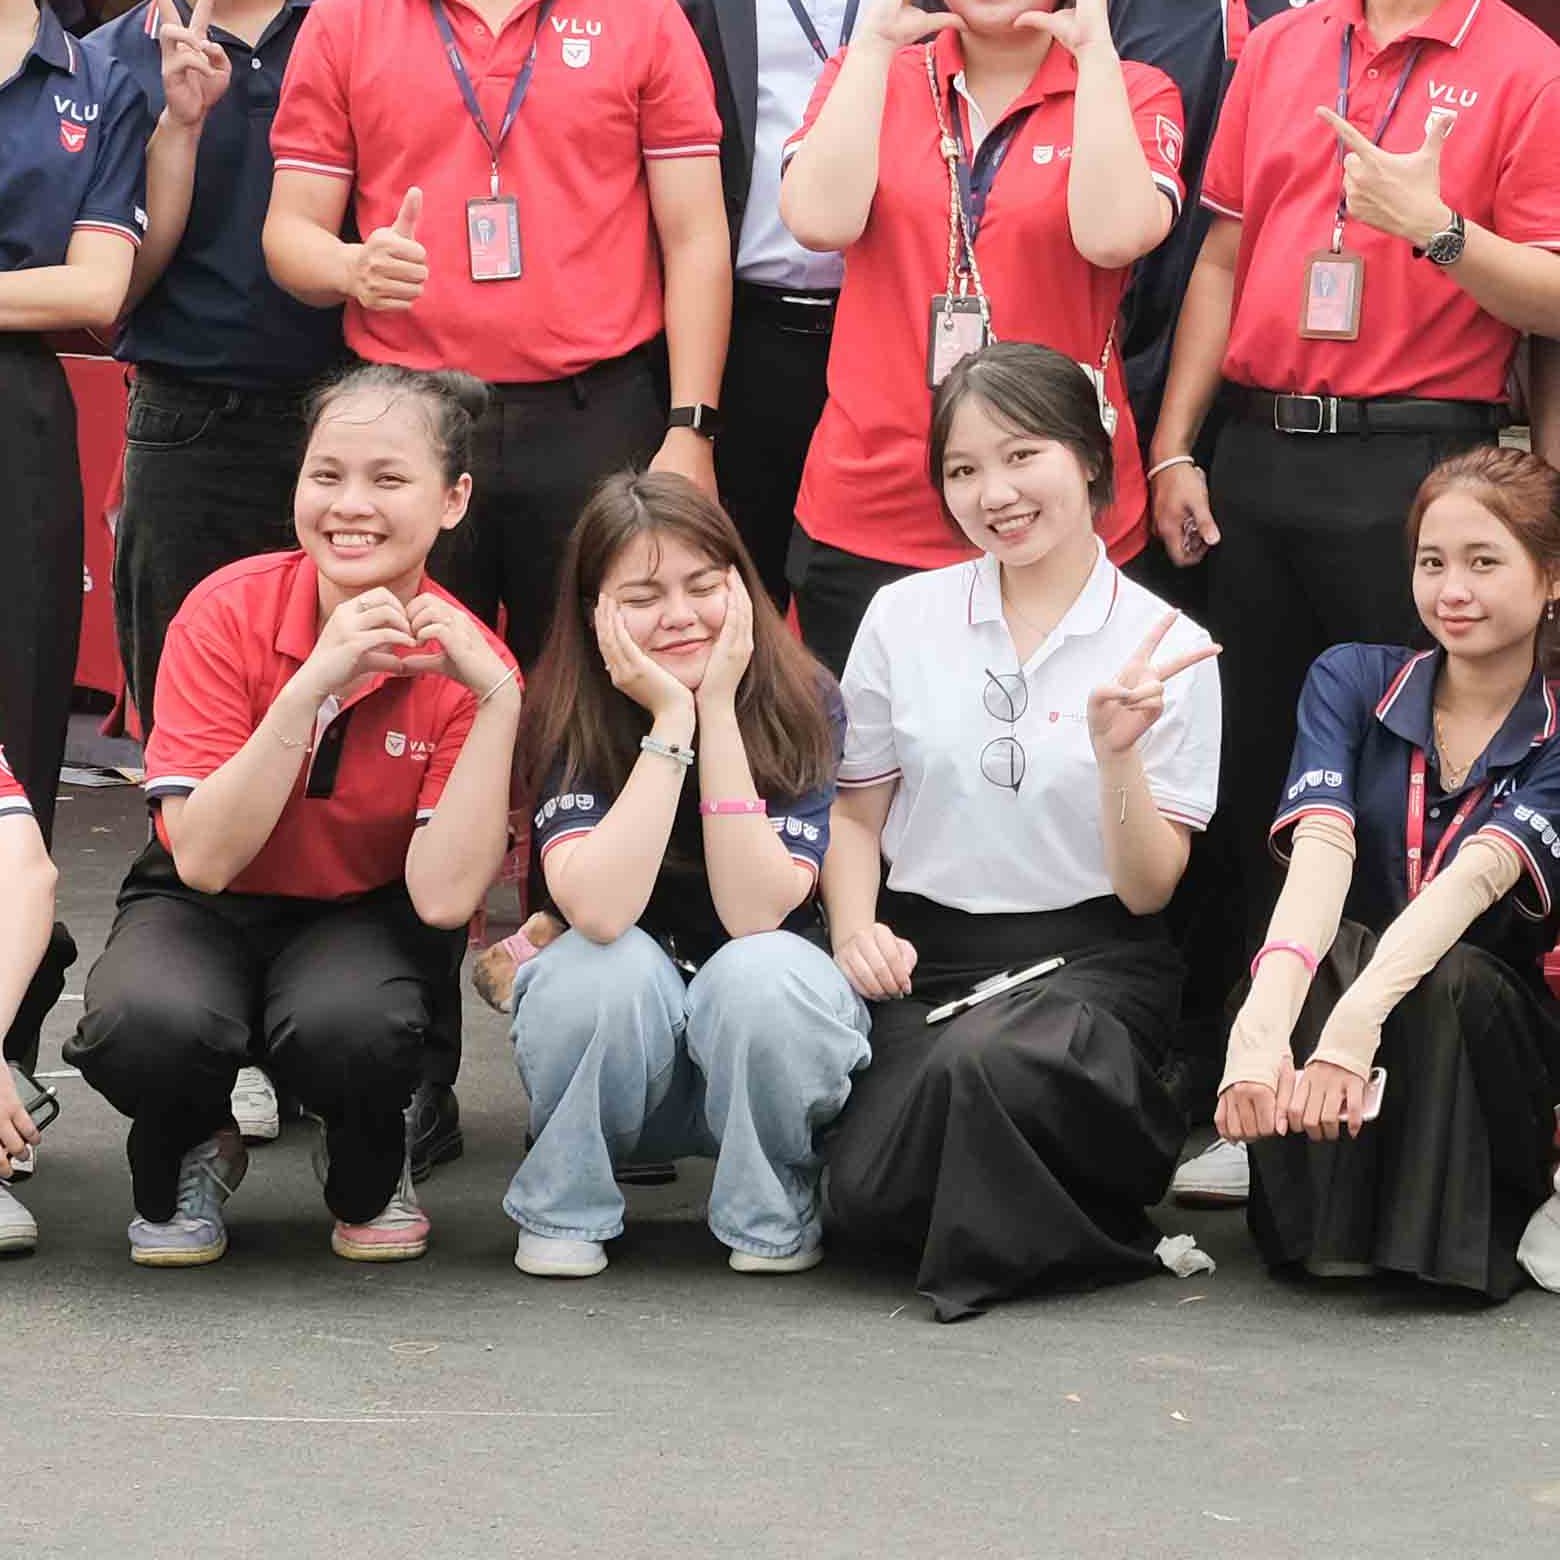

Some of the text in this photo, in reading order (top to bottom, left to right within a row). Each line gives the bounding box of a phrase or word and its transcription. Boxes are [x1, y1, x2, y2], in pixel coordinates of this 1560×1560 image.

[551, 16, 602, 37] VLU
[1428, 79, 1479, 107] VLU
[53, 95, 100, 122] VLU
